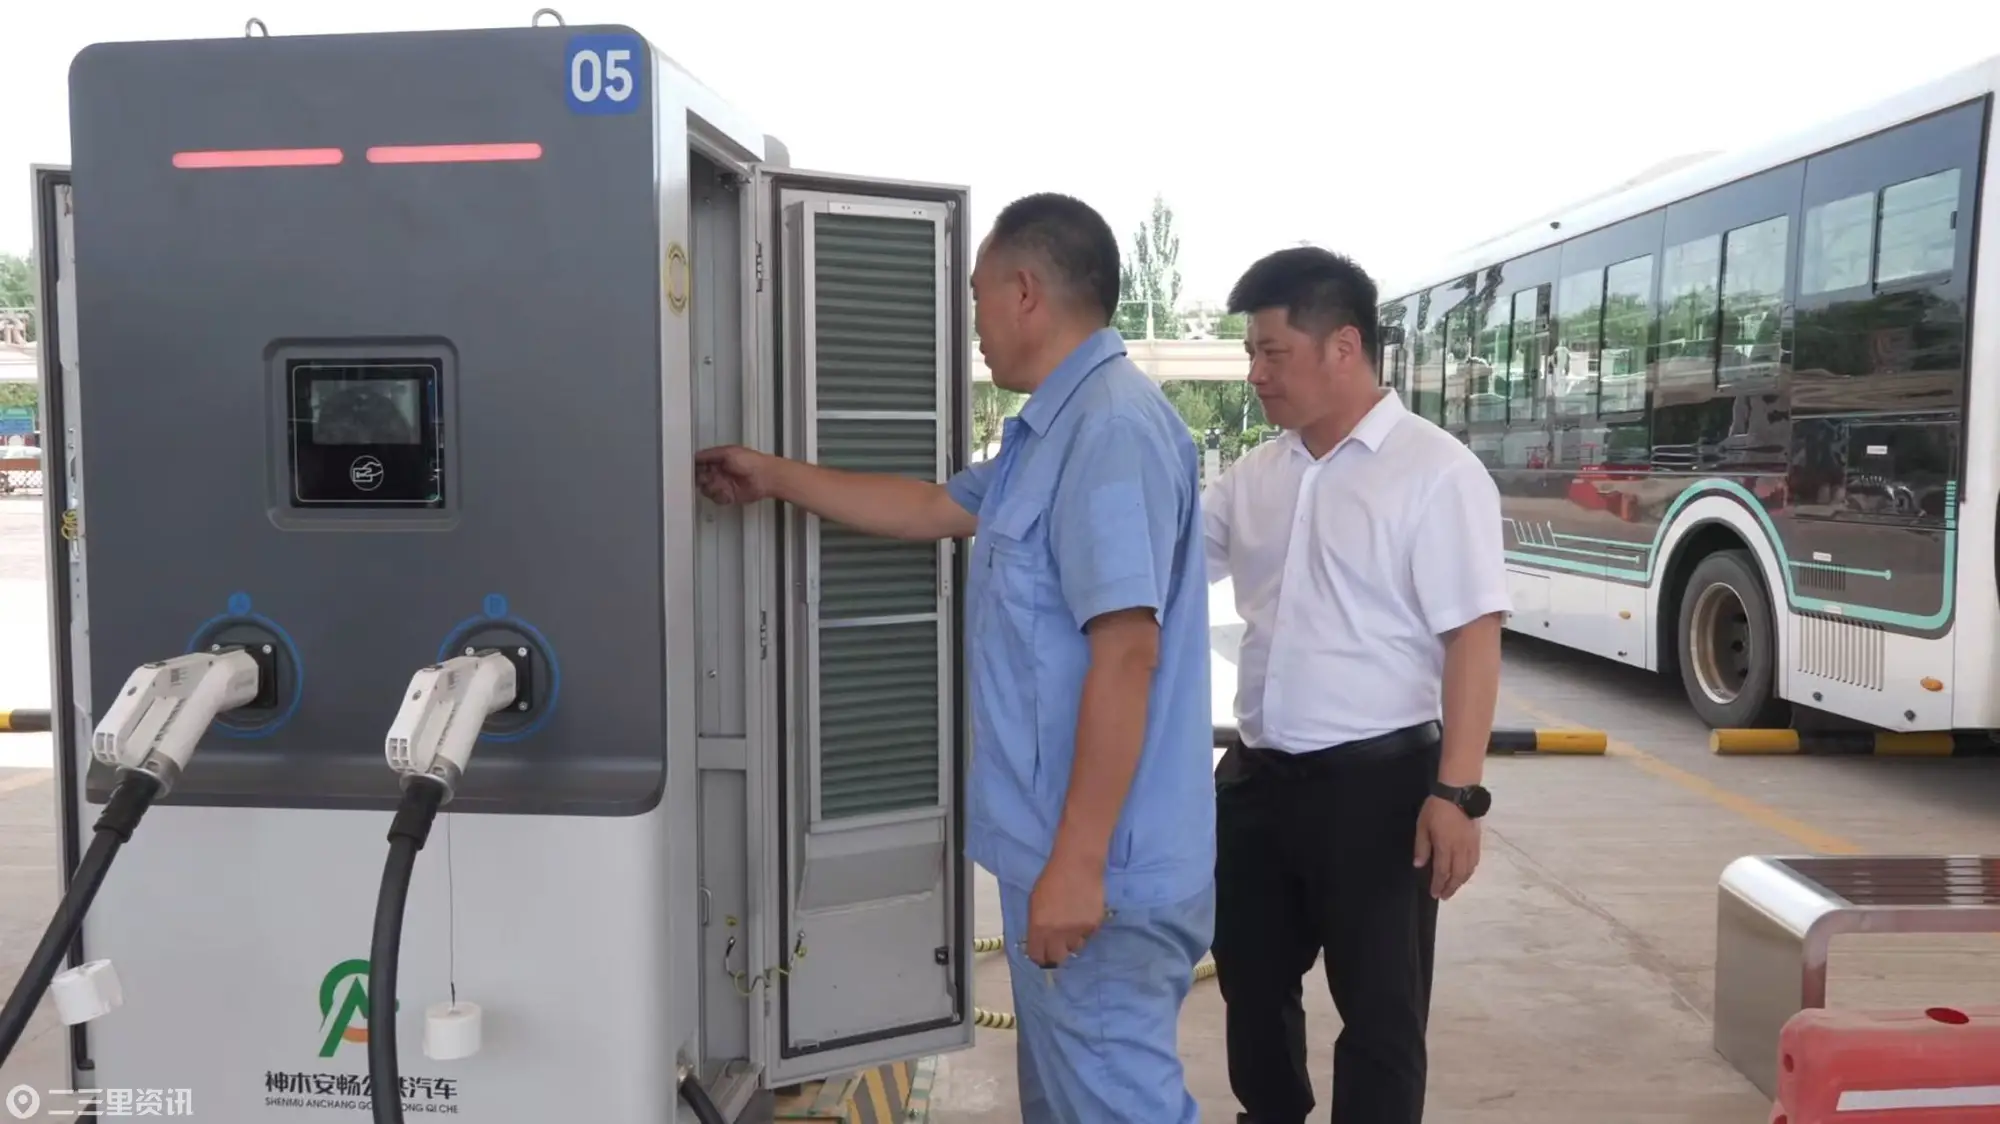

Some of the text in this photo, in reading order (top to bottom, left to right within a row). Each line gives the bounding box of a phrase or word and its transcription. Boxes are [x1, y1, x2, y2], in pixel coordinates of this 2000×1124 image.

[571, 49, 633, 102] 05
[265, 1097, 458, 1114] SHENMU ANCHANG GOONG QI CHE
